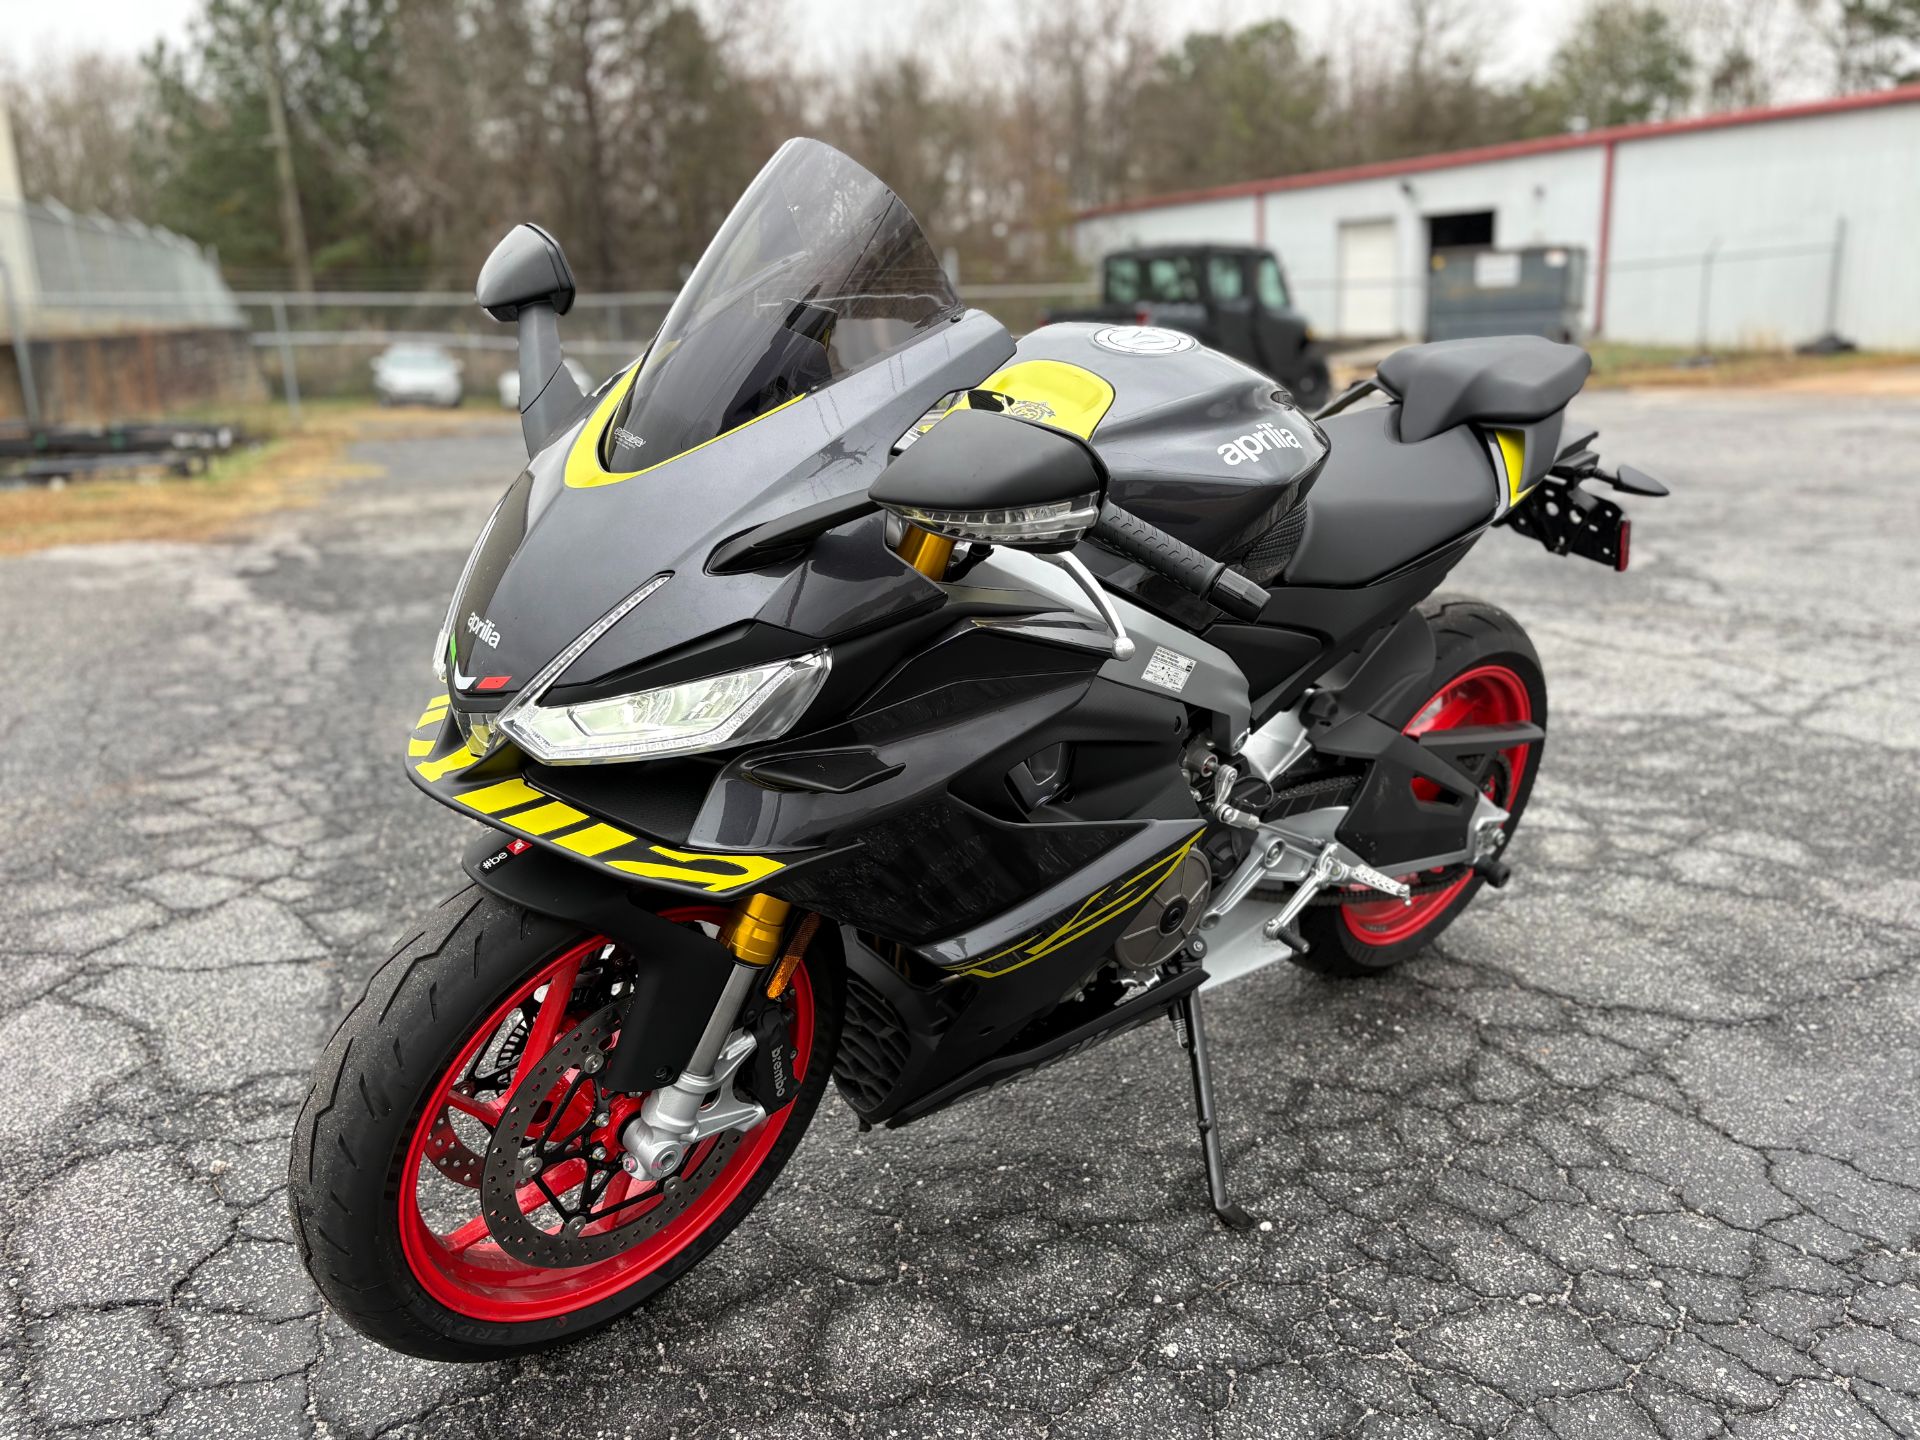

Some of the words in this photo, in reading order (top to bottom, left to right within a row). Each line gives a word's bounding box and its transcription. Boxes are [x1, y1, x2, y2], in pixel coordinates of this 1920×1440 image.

[1217, 422, 1303, 466] aprilia
[467, 611, 501, 649] aprilia
[482, 852, 508, 869] #be
[771, 1044, 786, 1097] brembo
